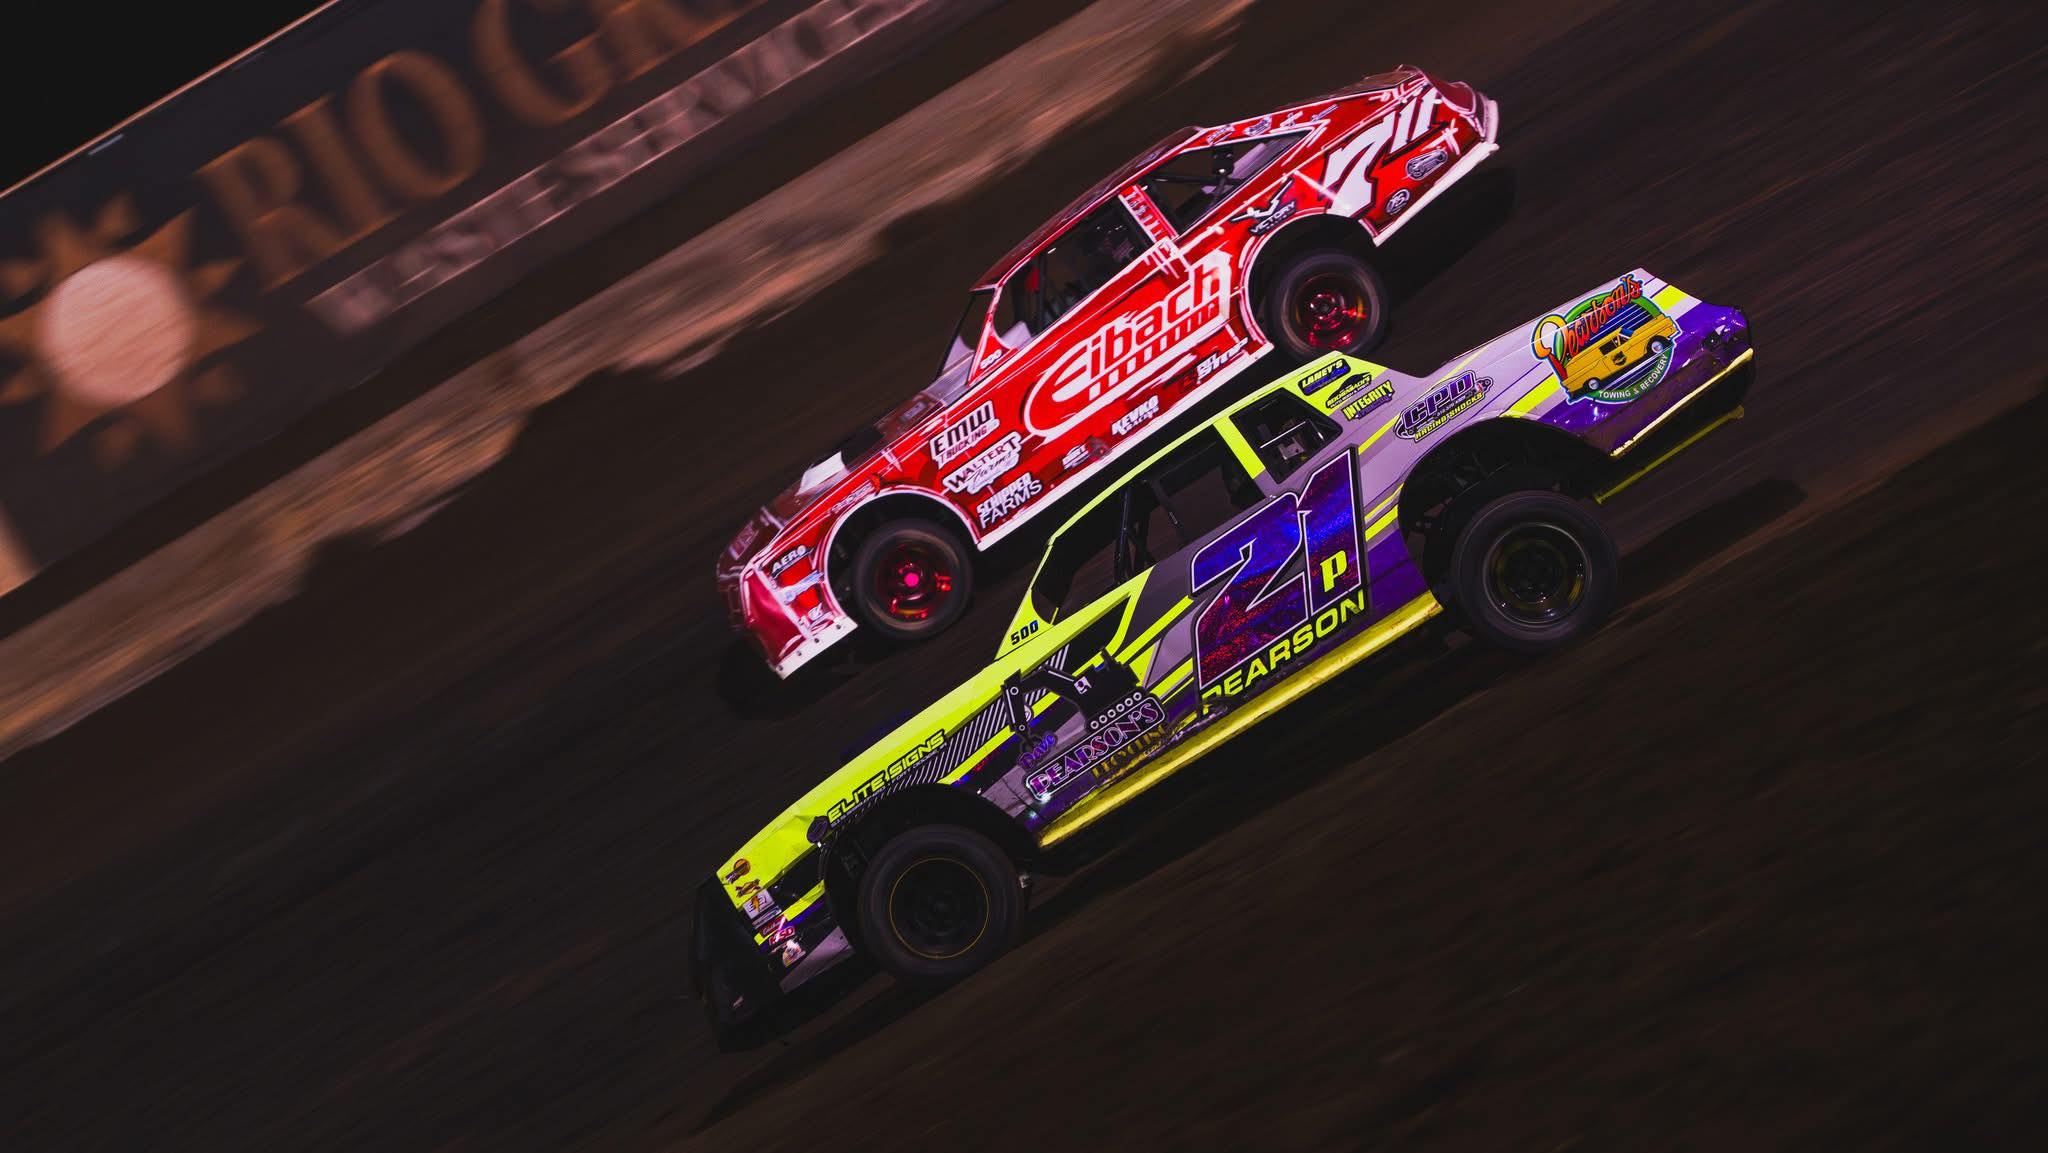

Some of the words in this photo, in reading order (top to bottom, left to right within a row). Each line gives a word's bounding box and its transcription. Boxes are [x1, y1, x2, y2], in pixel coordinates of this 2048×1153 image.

[195, 50, 485, 293] RIO
[472, 0, 766, 127] GR
[1251, 203, 1297, 234] VICTORY
[1029, 259, 1230, 430] Eibach
[1342, 380, 1392, 419] INTEGRITY
[1402, 372, 1474, 429] CPD
[1598, 388, 1631, 400] TOWING
[1639, 353, 1669, 392] RECOVERY
[932, 403, 994, 455] EMW
[1415, 415, 1447, 439] RACING
[1449, 392, 1482, 417] SHOCKS
[948, 437, 1017, 487] WALTERT
[980, 478, 1042, 528] FARMS
[1191, 449, 1363, 690] 21
[1011, 619, 1040, 646] 500
[1029, 702, 1160, 795] PEARSON'S
[828, 773, 884, 821] ELITE
[885, 730, 944, 780] SIGNS
